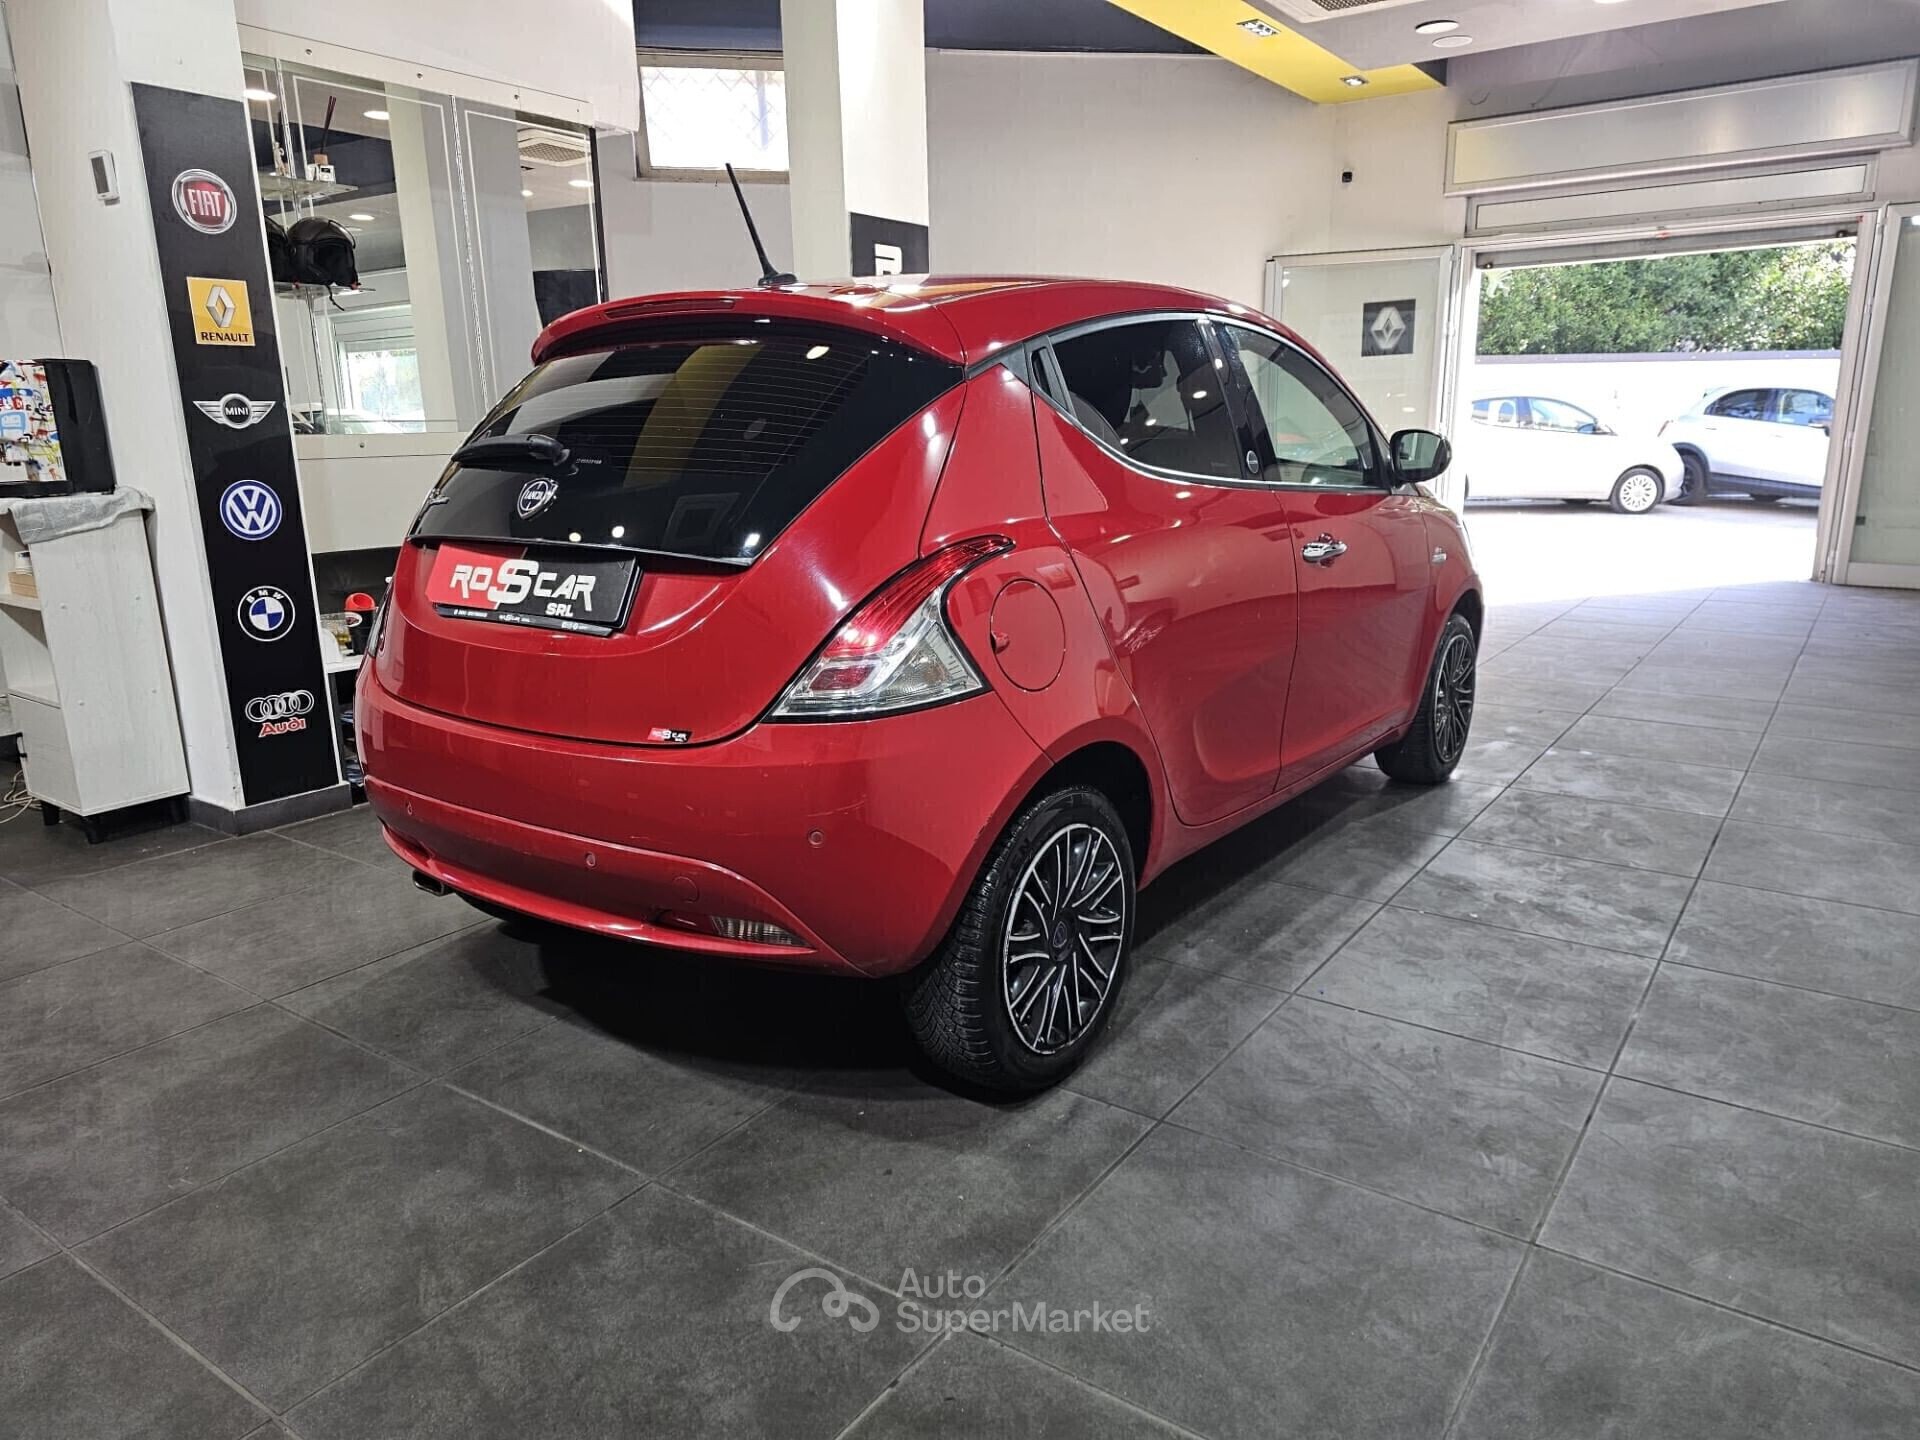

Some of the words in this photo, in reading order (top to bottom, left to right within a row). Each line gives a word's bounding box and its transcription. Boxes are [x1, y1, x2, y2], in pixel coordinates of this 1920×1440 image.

[187, 188, 221, 217] FIAT
[200, 331, 249, 343] RENAULT
[225, 407, 249, 416] MINI
[245, 589, 285, 604] BMW
[545, 602, 574, 618] SRL
[258, 717, 306, 738] Audi
